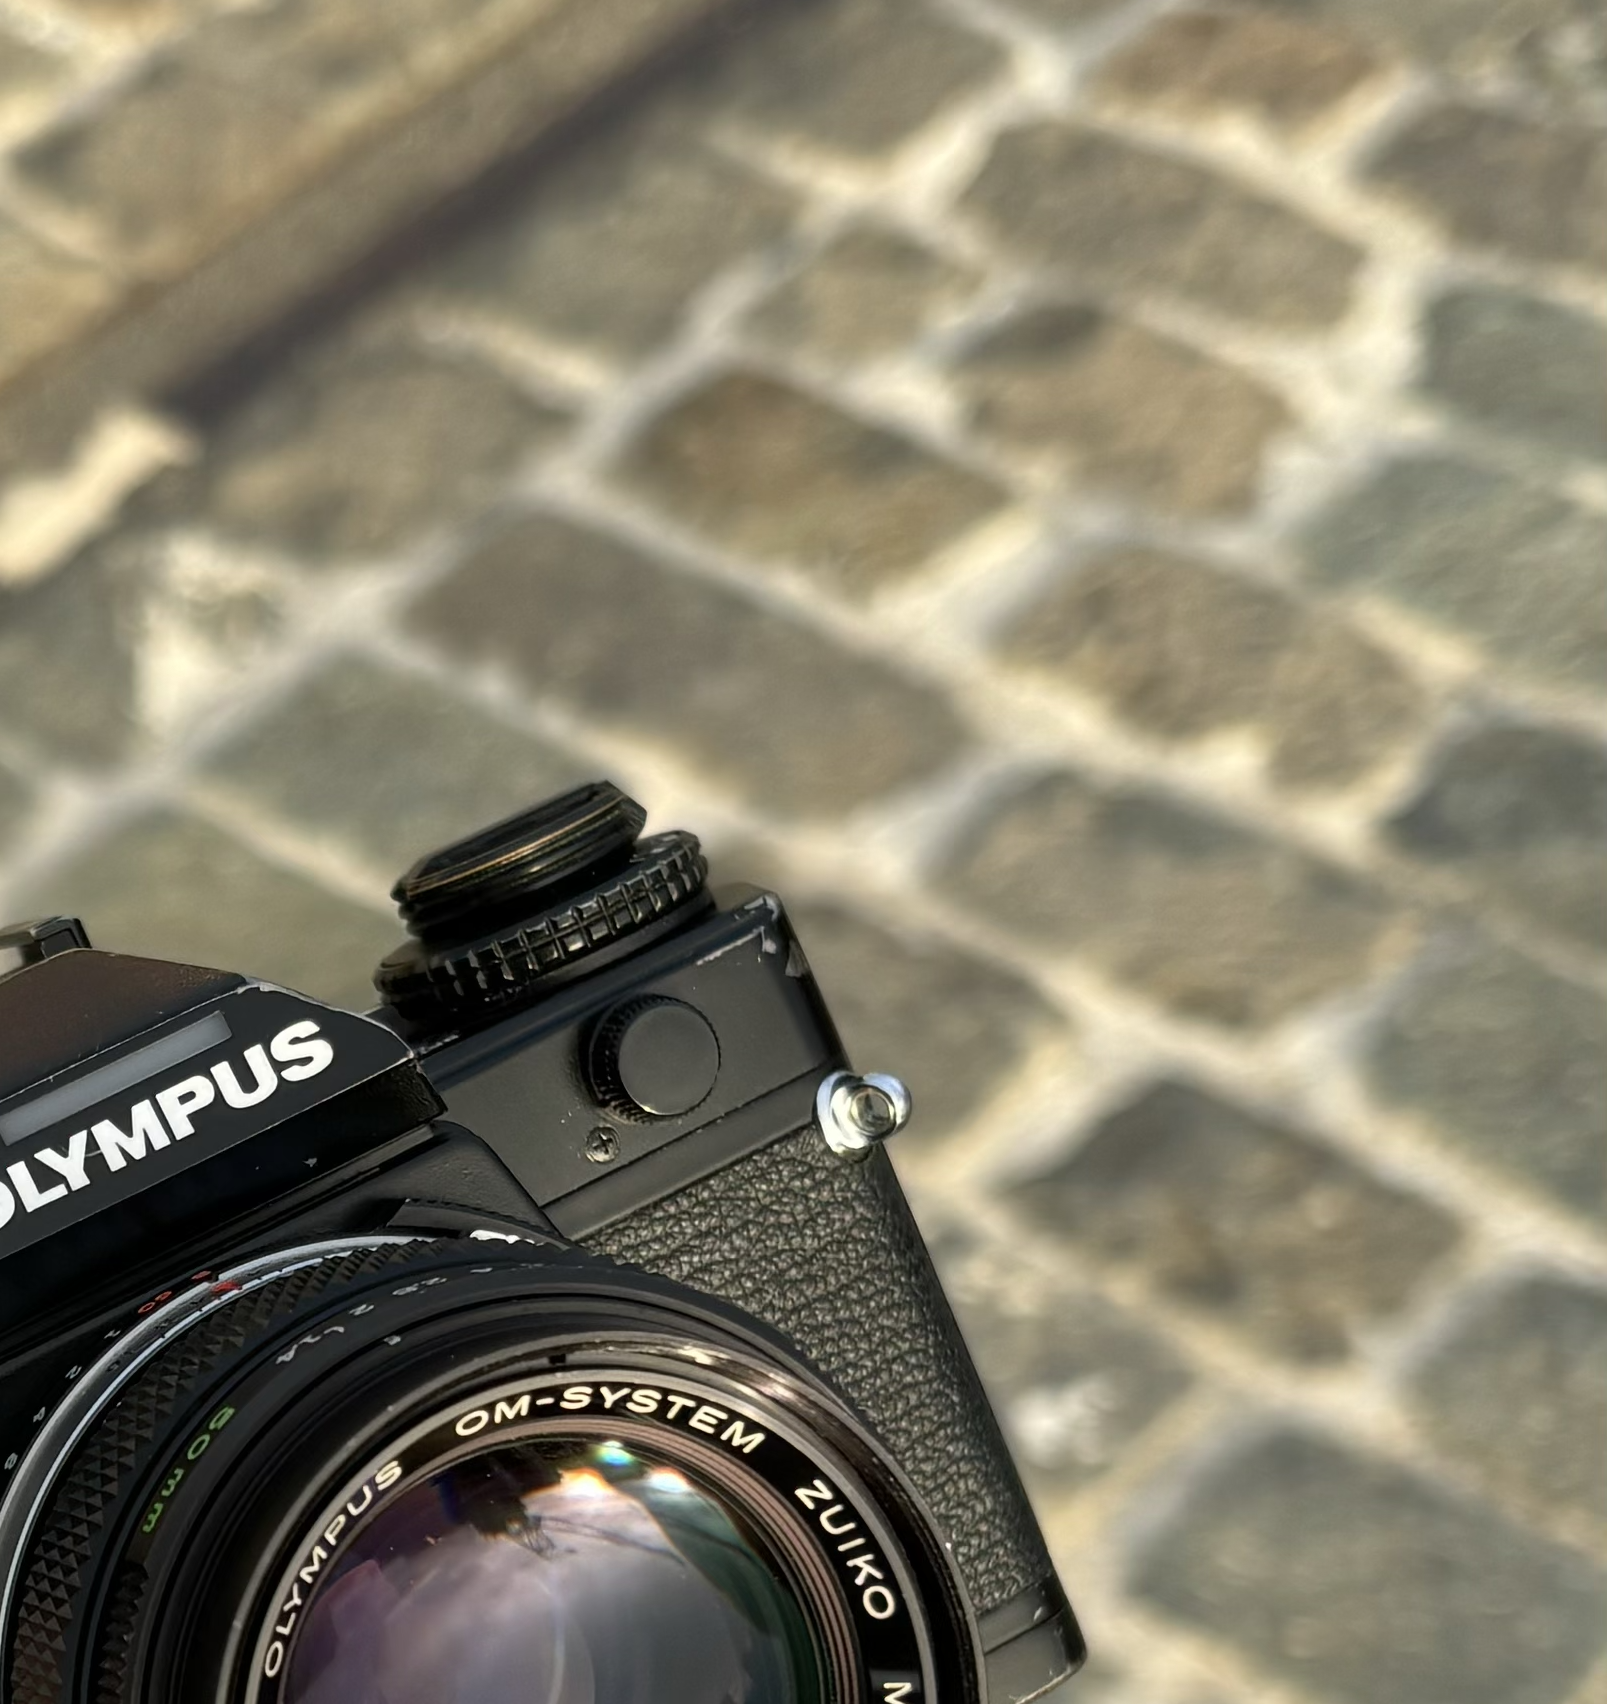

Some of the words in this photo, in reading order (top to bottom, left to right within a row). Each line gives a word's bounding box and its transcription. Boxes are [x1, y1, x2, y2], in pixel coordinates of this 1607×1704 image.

[454, 1385, 767, 1454] OM-SYSTEM
[263, 1459, 404, 1679] OLYMPUS
[794, 1479, 897, 1621] ZUIKO
